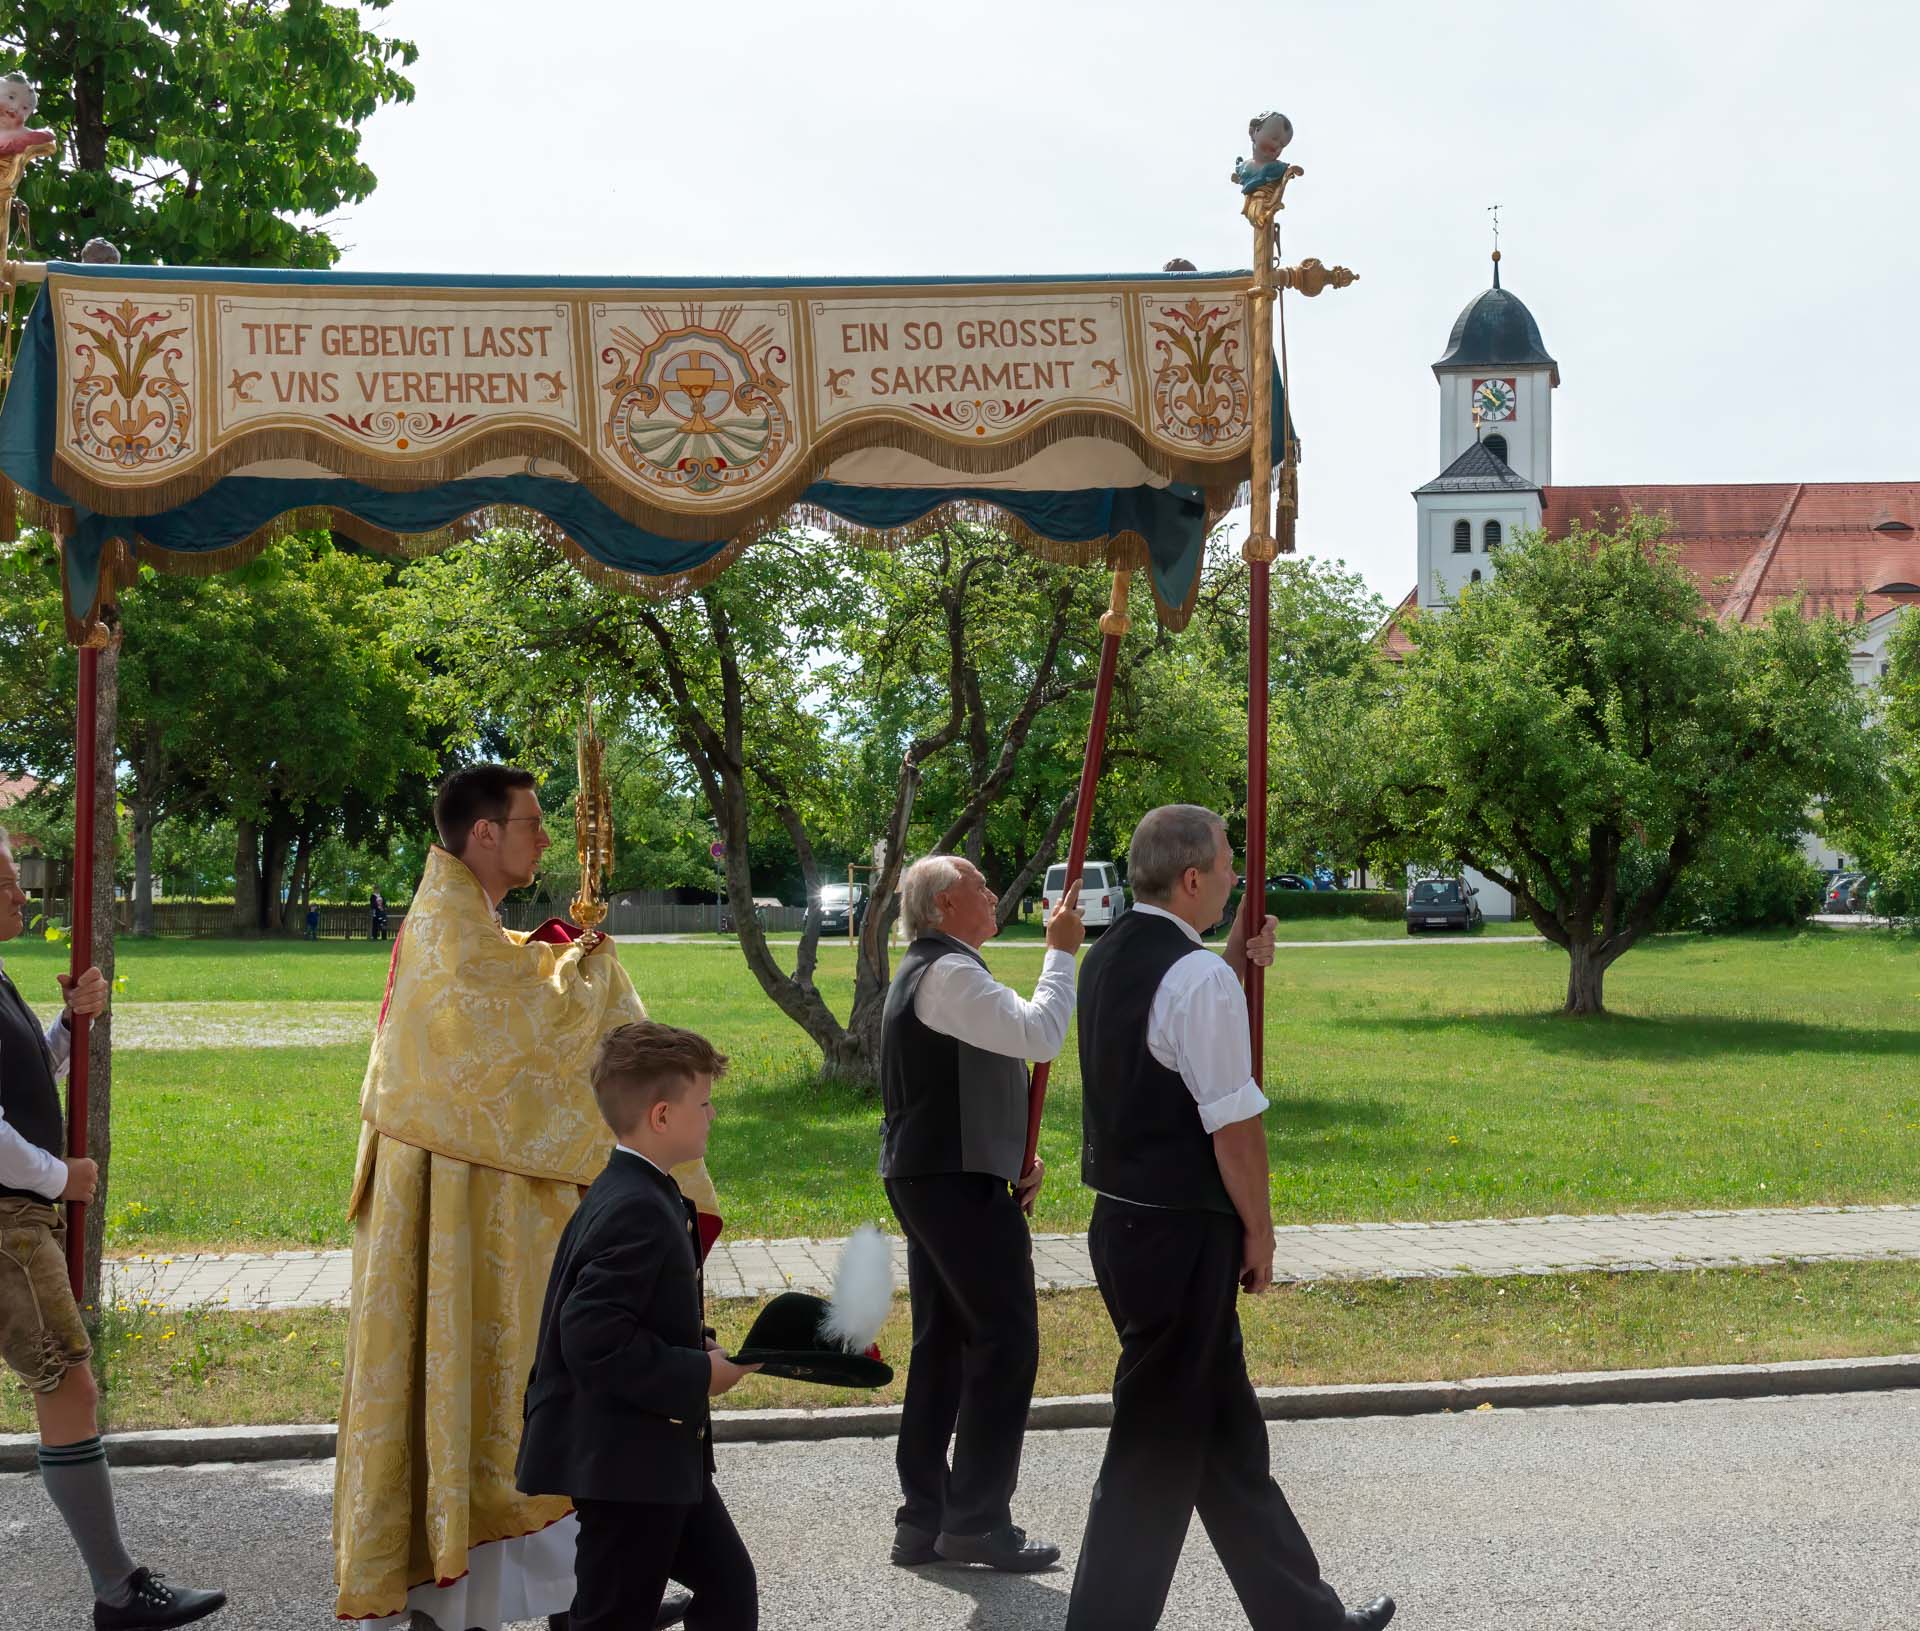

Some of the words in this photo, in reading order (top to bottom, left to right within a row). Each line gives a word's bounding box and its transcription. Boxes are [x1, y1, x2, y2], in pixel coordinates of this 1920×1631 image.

[241, 323, 312, 356] TIEF
[463, 326, 552, 357] LASST
[841, 323, 889, 353] EIN
[903, 321, 943, 351] SO
[957, 318, 1097, 350] GROSSES
[271, 371, 339, 403] VNS
[355, 372, 528, 403] VEREHREN
[870, 360, 1074, 395] SAKRAMENT
